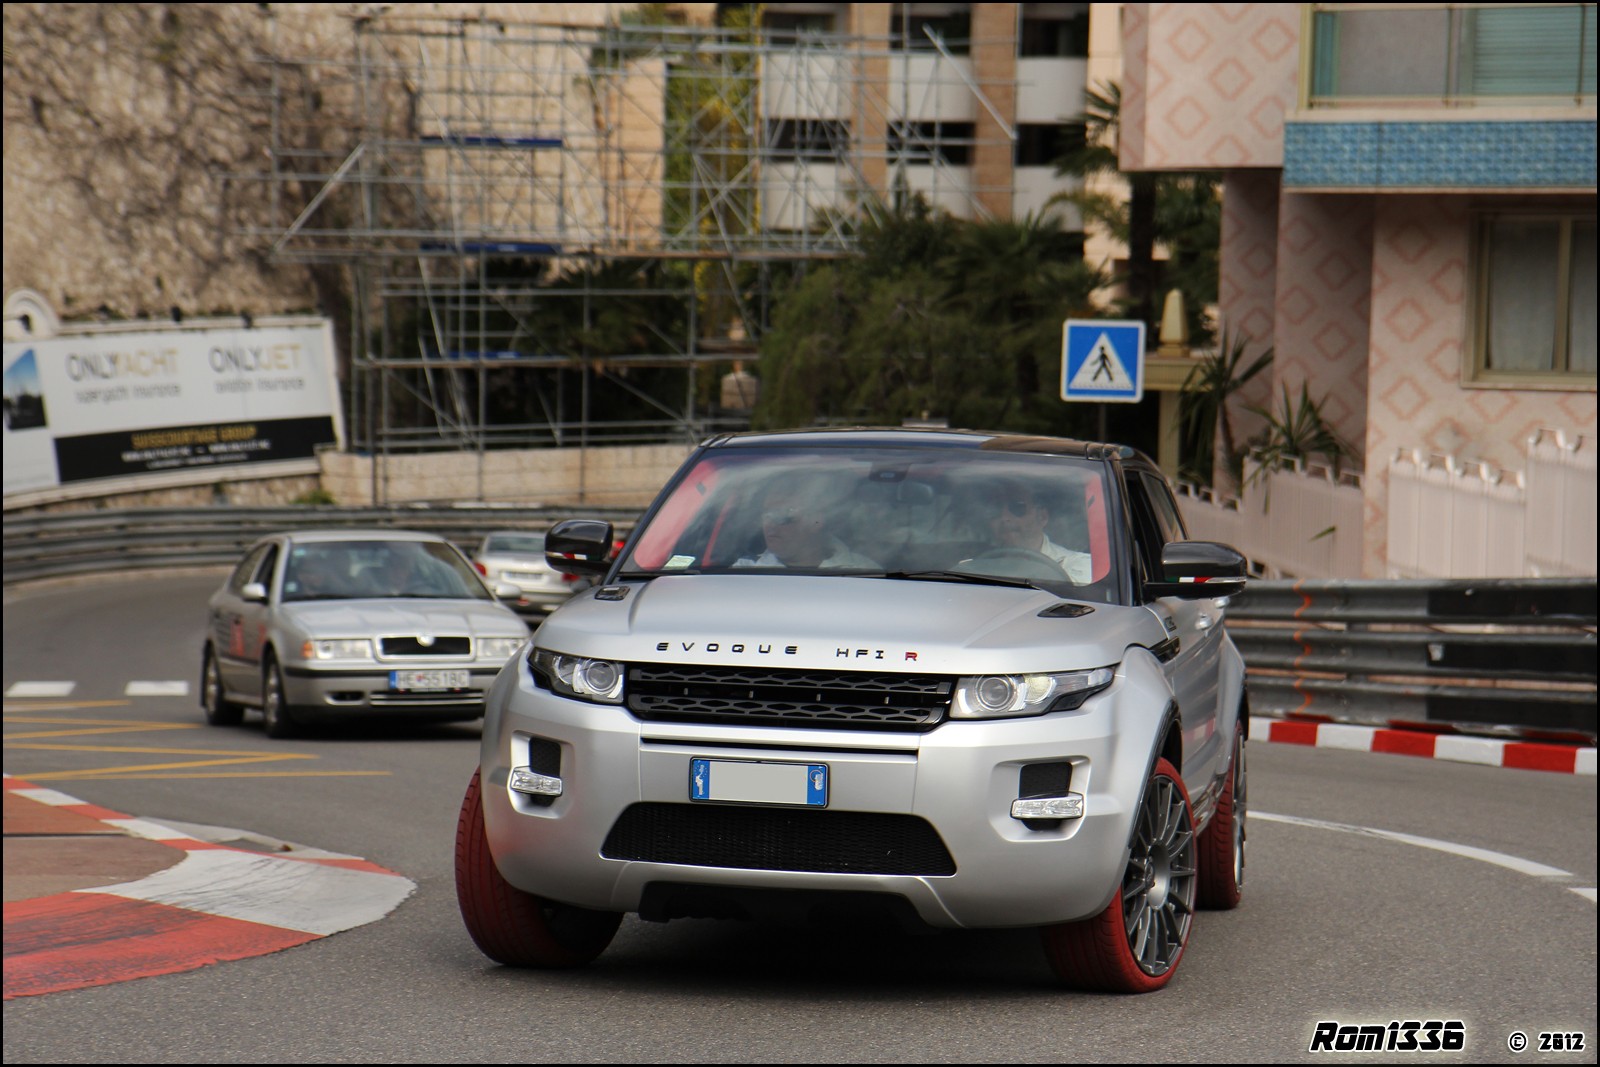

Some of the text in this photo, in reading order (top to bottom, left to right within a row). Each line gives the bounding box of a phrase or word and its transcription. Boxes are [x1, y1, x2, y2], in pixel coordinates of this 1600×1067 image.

[656, 641, 918, 661] EVOQUE HFI R
